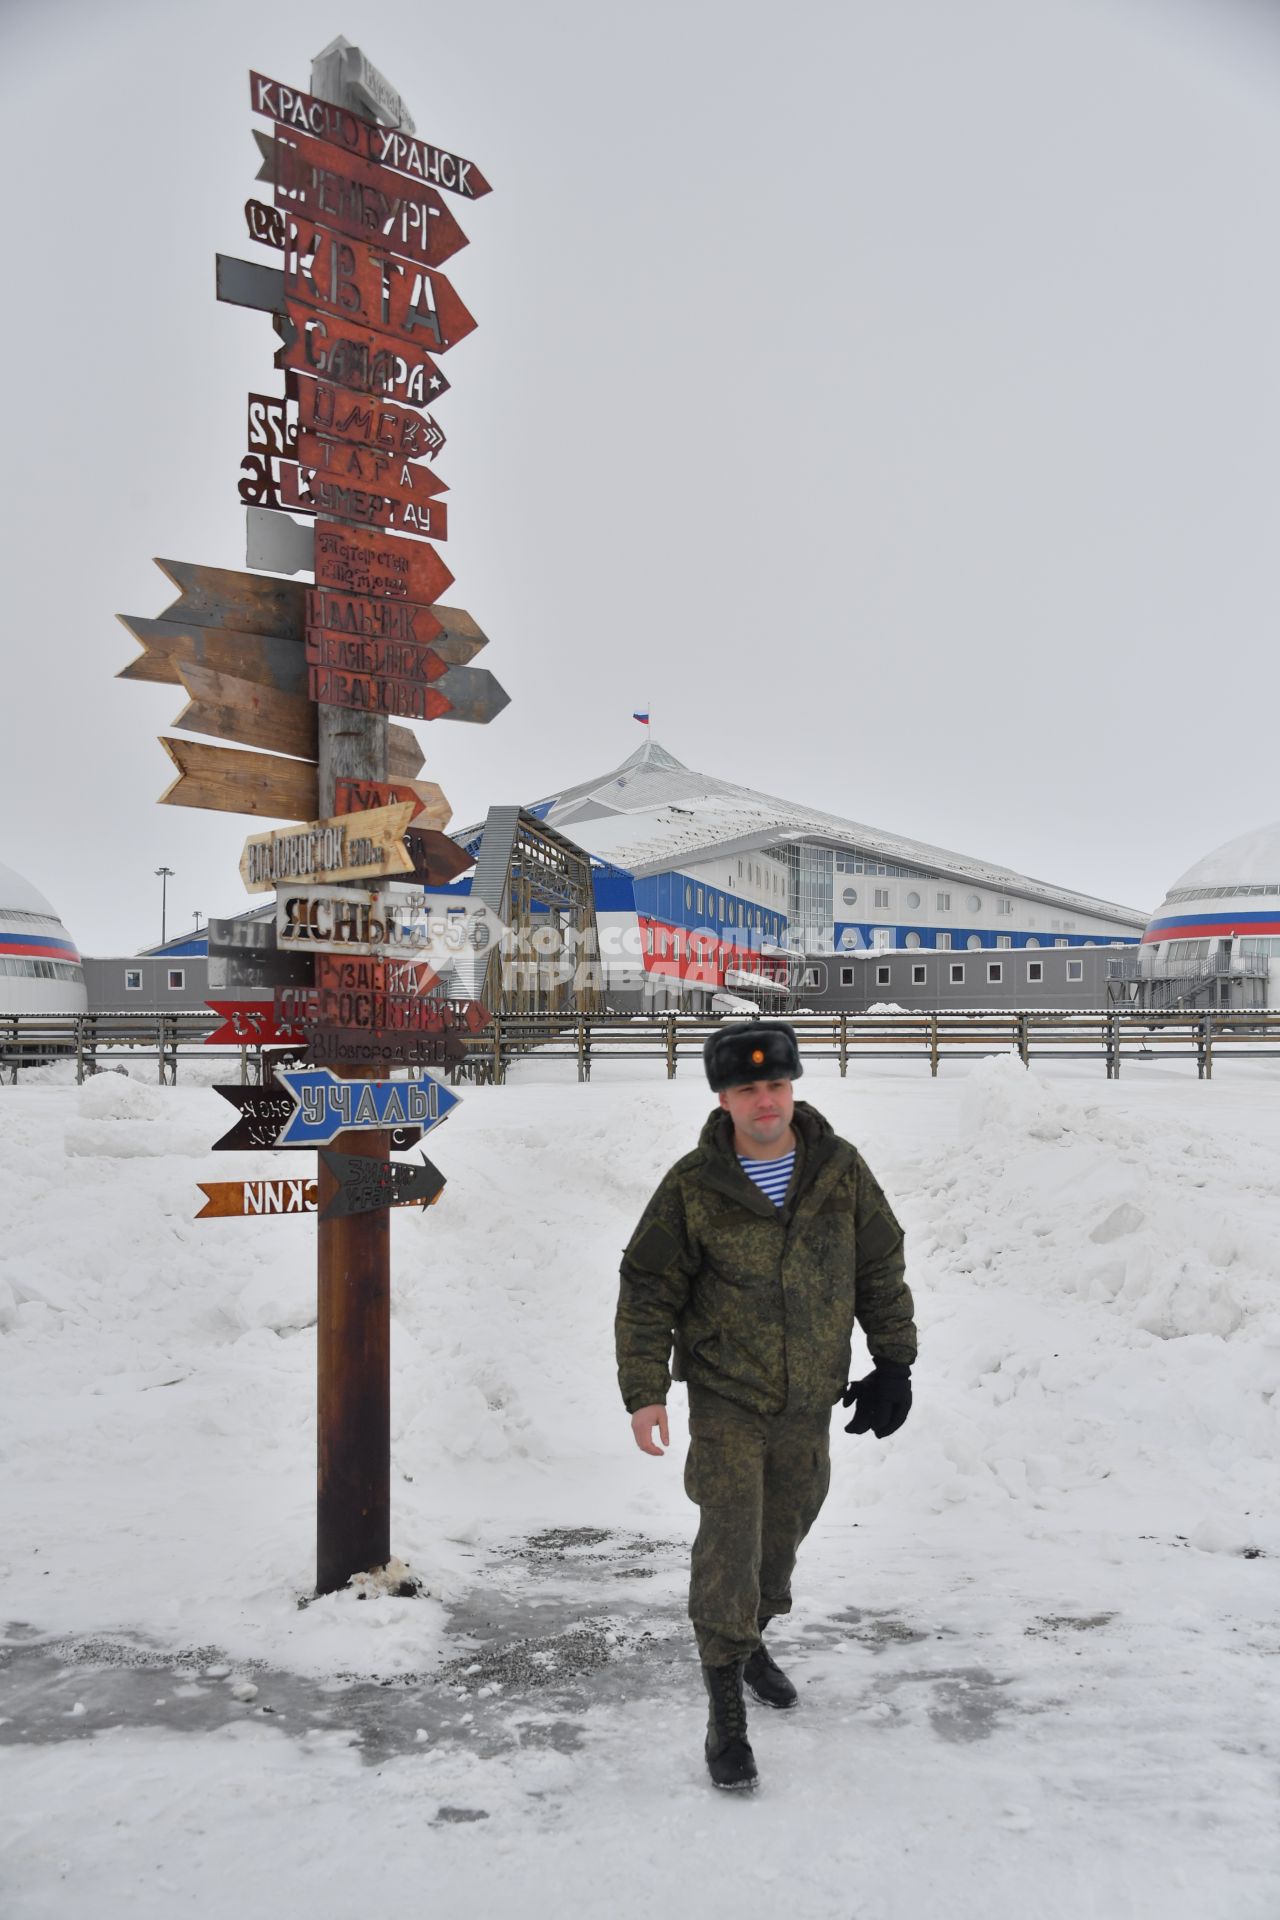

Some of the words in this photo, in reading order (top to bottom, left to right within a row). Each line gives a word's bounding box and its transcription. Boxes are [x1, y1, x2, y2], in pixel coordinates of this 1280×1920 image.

[257, 79, 473, 195] КРАСНОТУРАНСК
[306, 321, 424, 401] САМАРА
[313, 386, 418, 452] ОМСК
[318, 442, 412, 488] ТАРА
[297, 467, 430, 530] КУМЕРТАУ
[309, 592, 418, 641] НАЛЬЧИК
[307, 630, 428, 681] ЧЕЛЯБИНСК
[318, 956, 419, 993] РУЗАЕВКА
[301, 1083, 439, 1124] УЧАЛЫ
